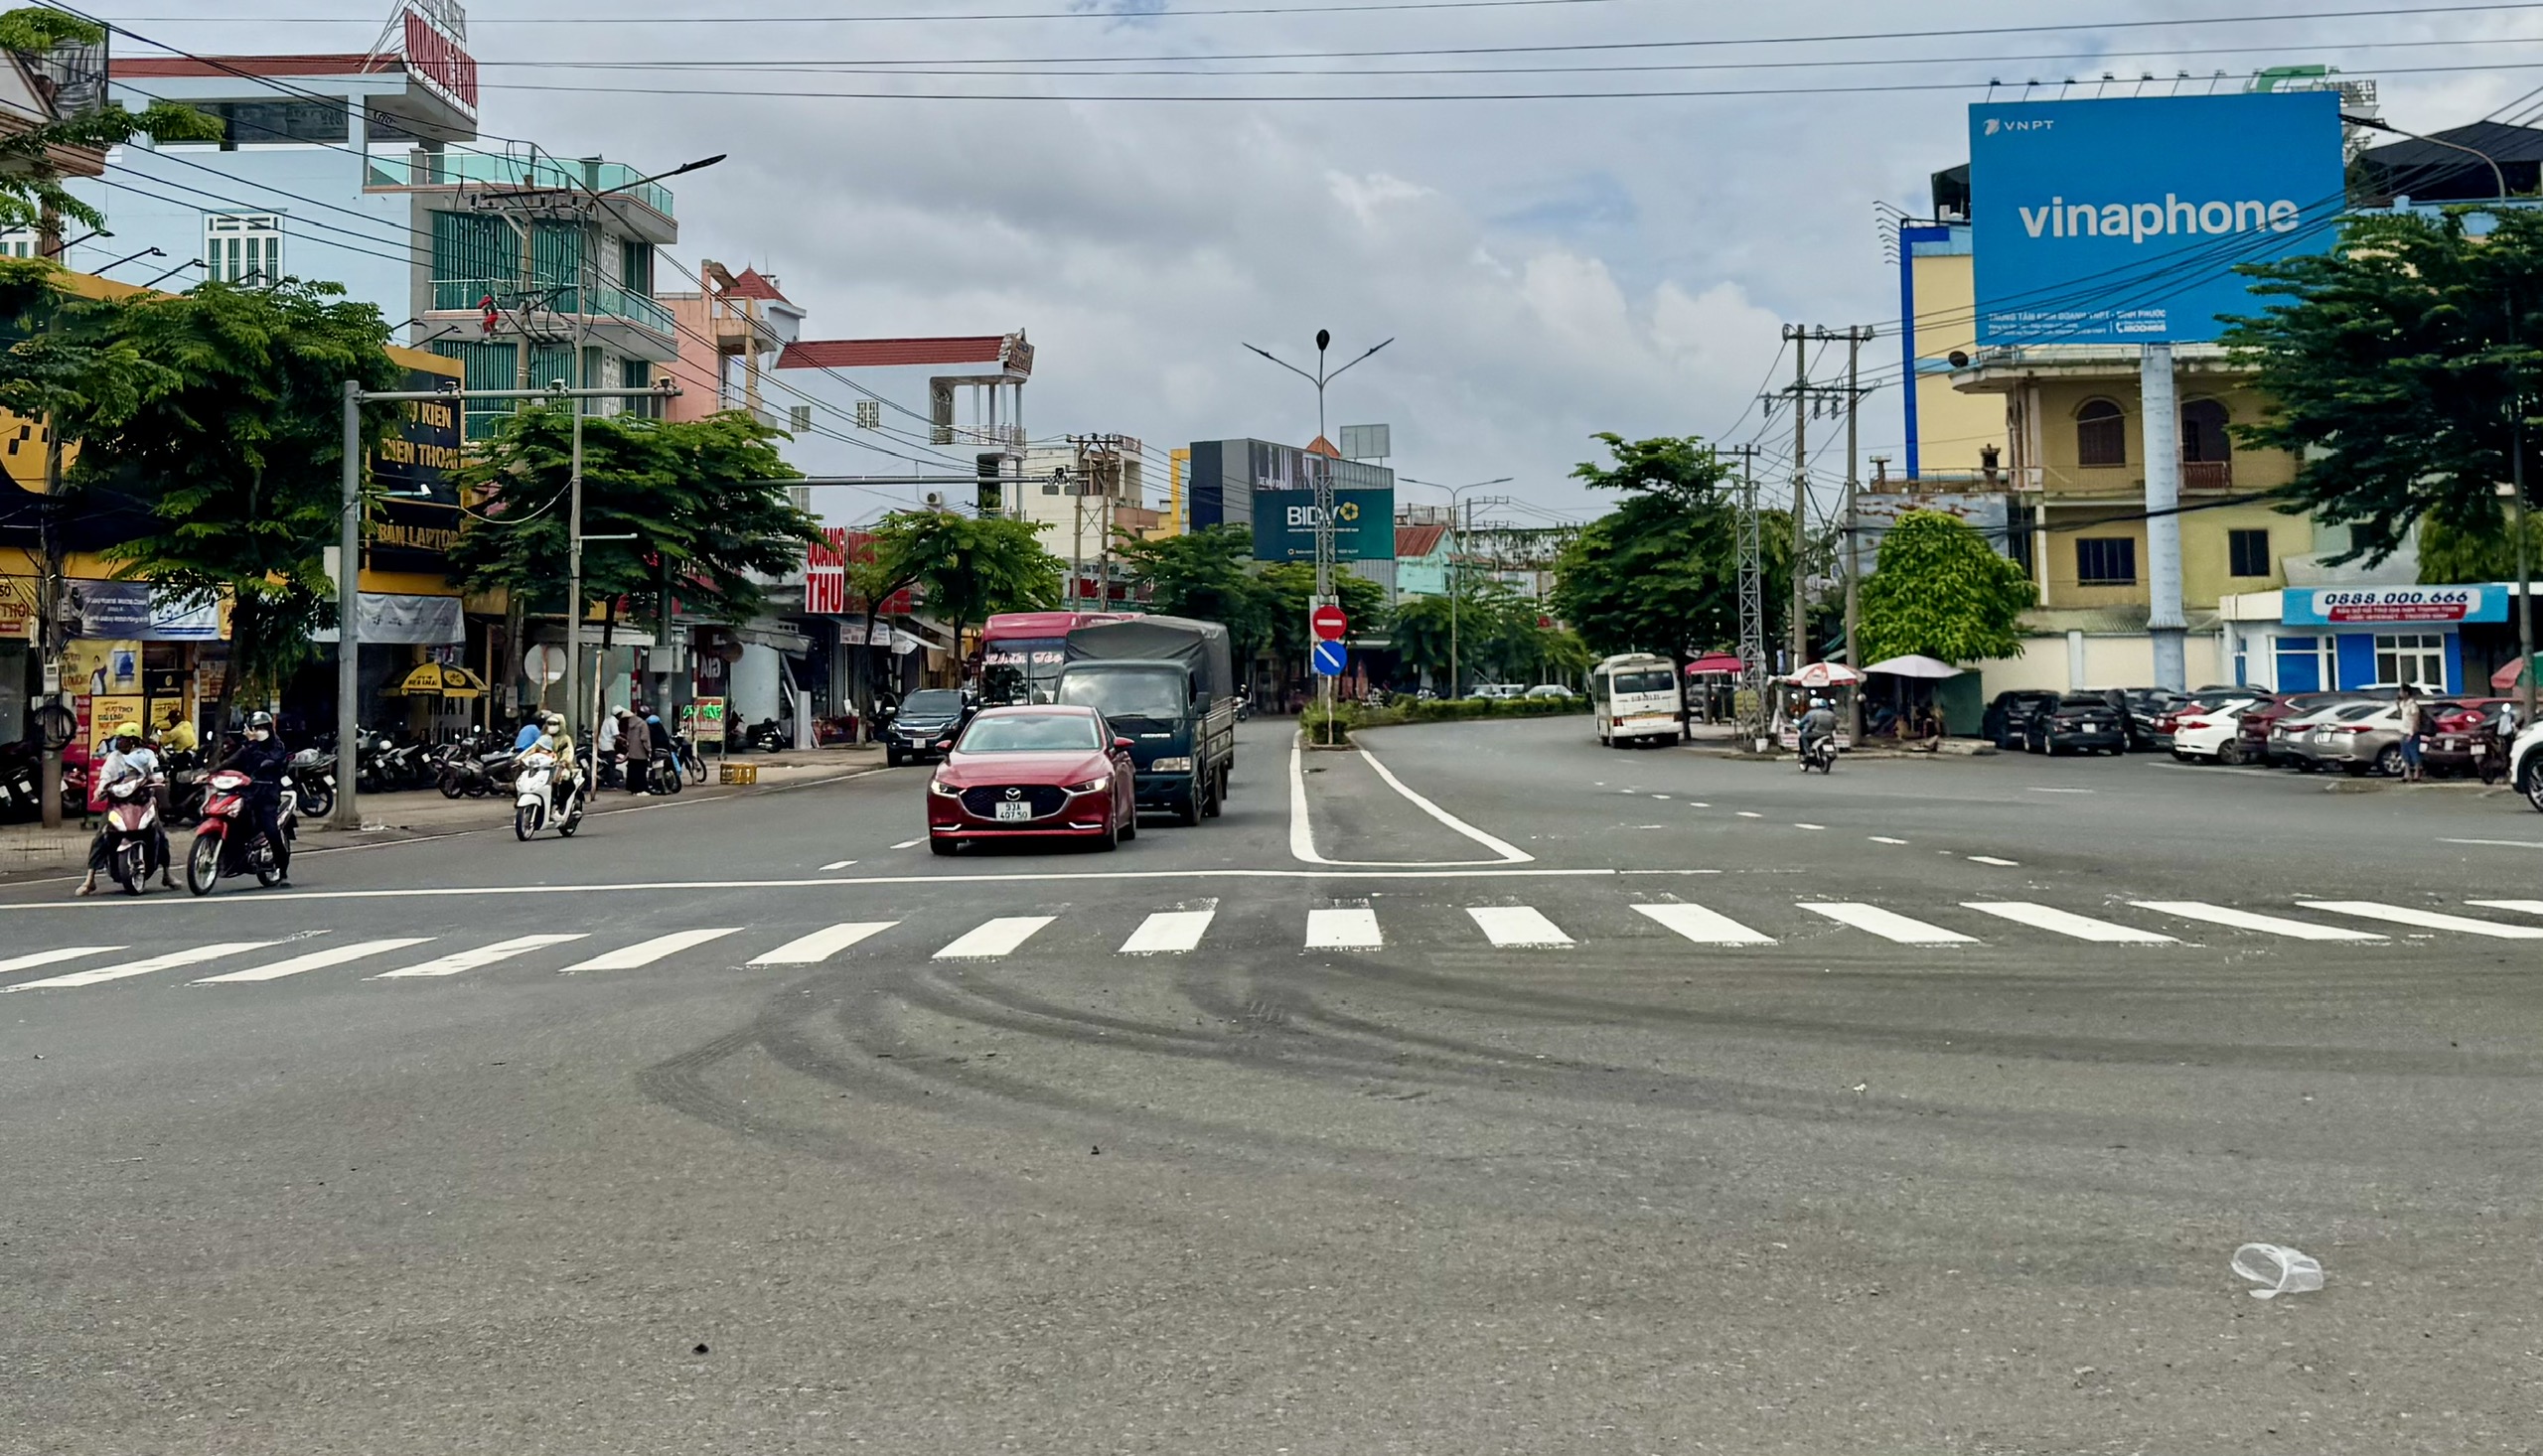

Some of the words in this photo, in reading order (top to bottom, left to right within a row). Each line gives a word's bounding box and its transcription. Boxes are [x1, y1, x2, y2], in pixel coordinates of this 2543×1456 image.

[2004, 118, 2054, 132] VNPT
[2019, 193, 2300, 243] vinaphone
[807, 573, 843, 613] THU
[2324, 591, 2468, 605] 0888.000.666
